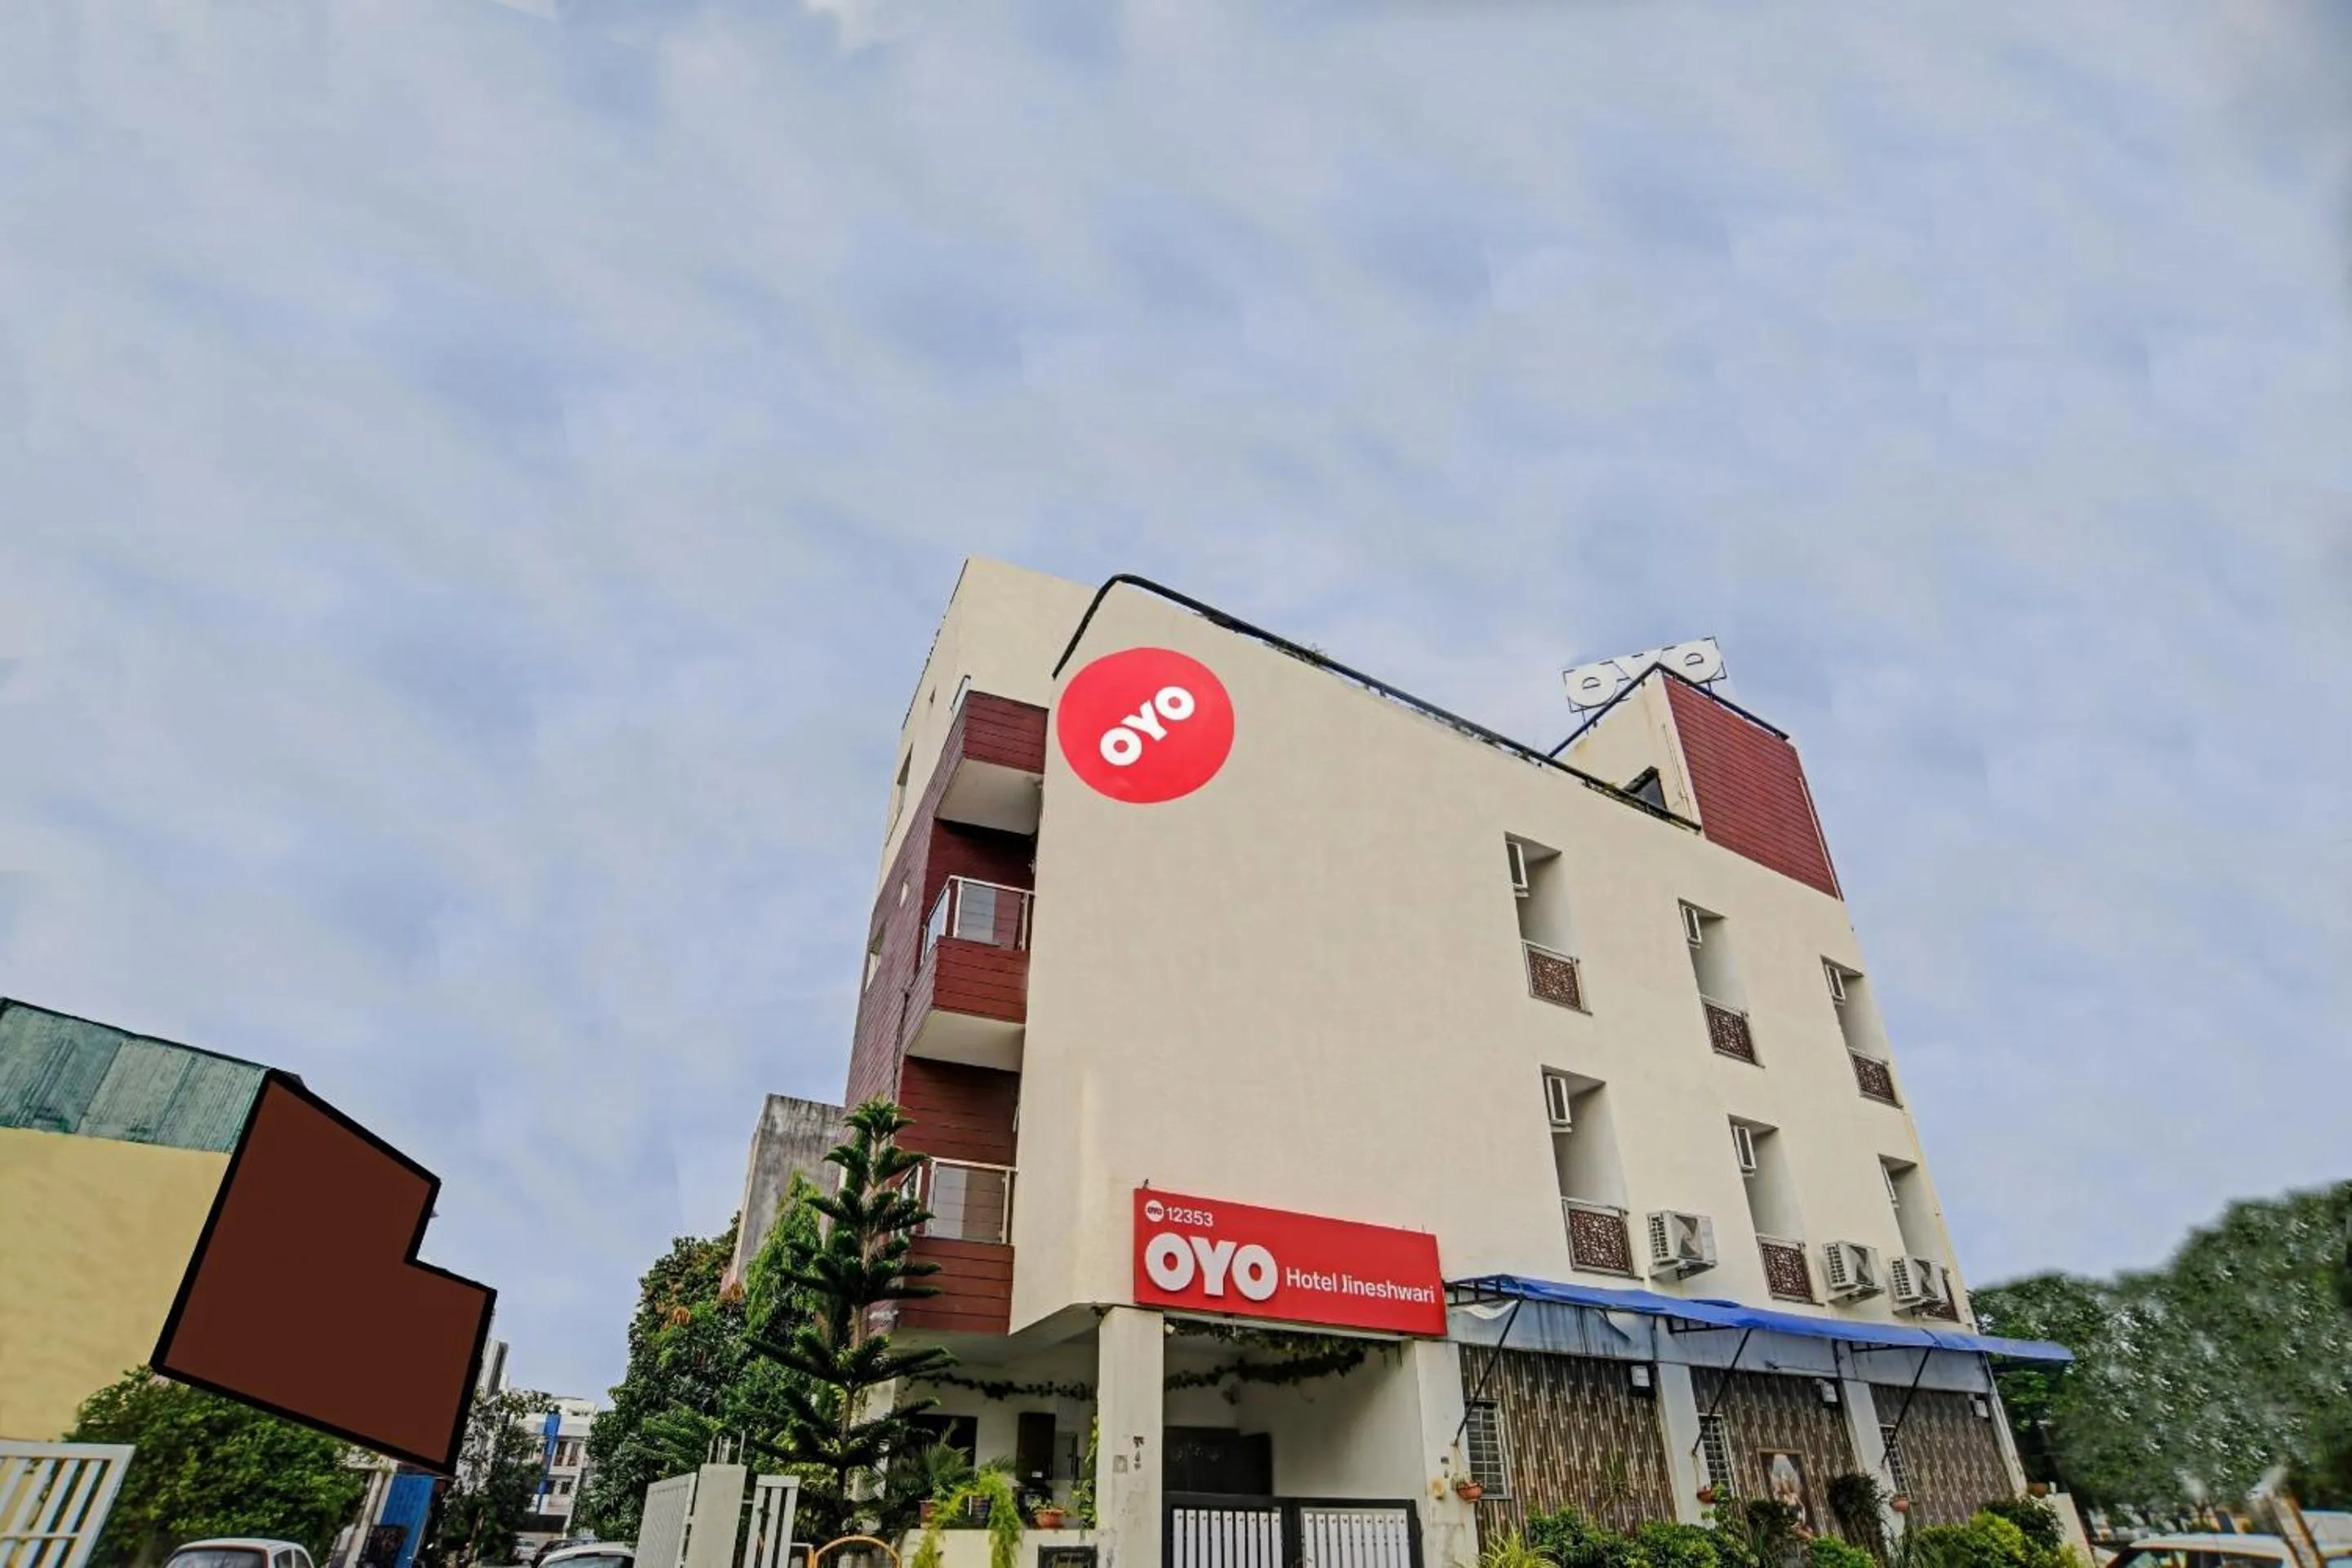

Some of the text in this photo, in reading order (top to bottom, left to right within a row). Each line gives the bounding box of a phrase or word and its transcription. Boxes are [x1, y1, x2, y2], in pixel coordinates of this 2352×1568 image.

[1100, 685, 1195, 766] OYO
[1165, 1206, 1214, 1227] 12353
[1145, 1232, 1278, 1301] OYO
[1286, 1266, 1435, 1304] Hotel Jineshwari
